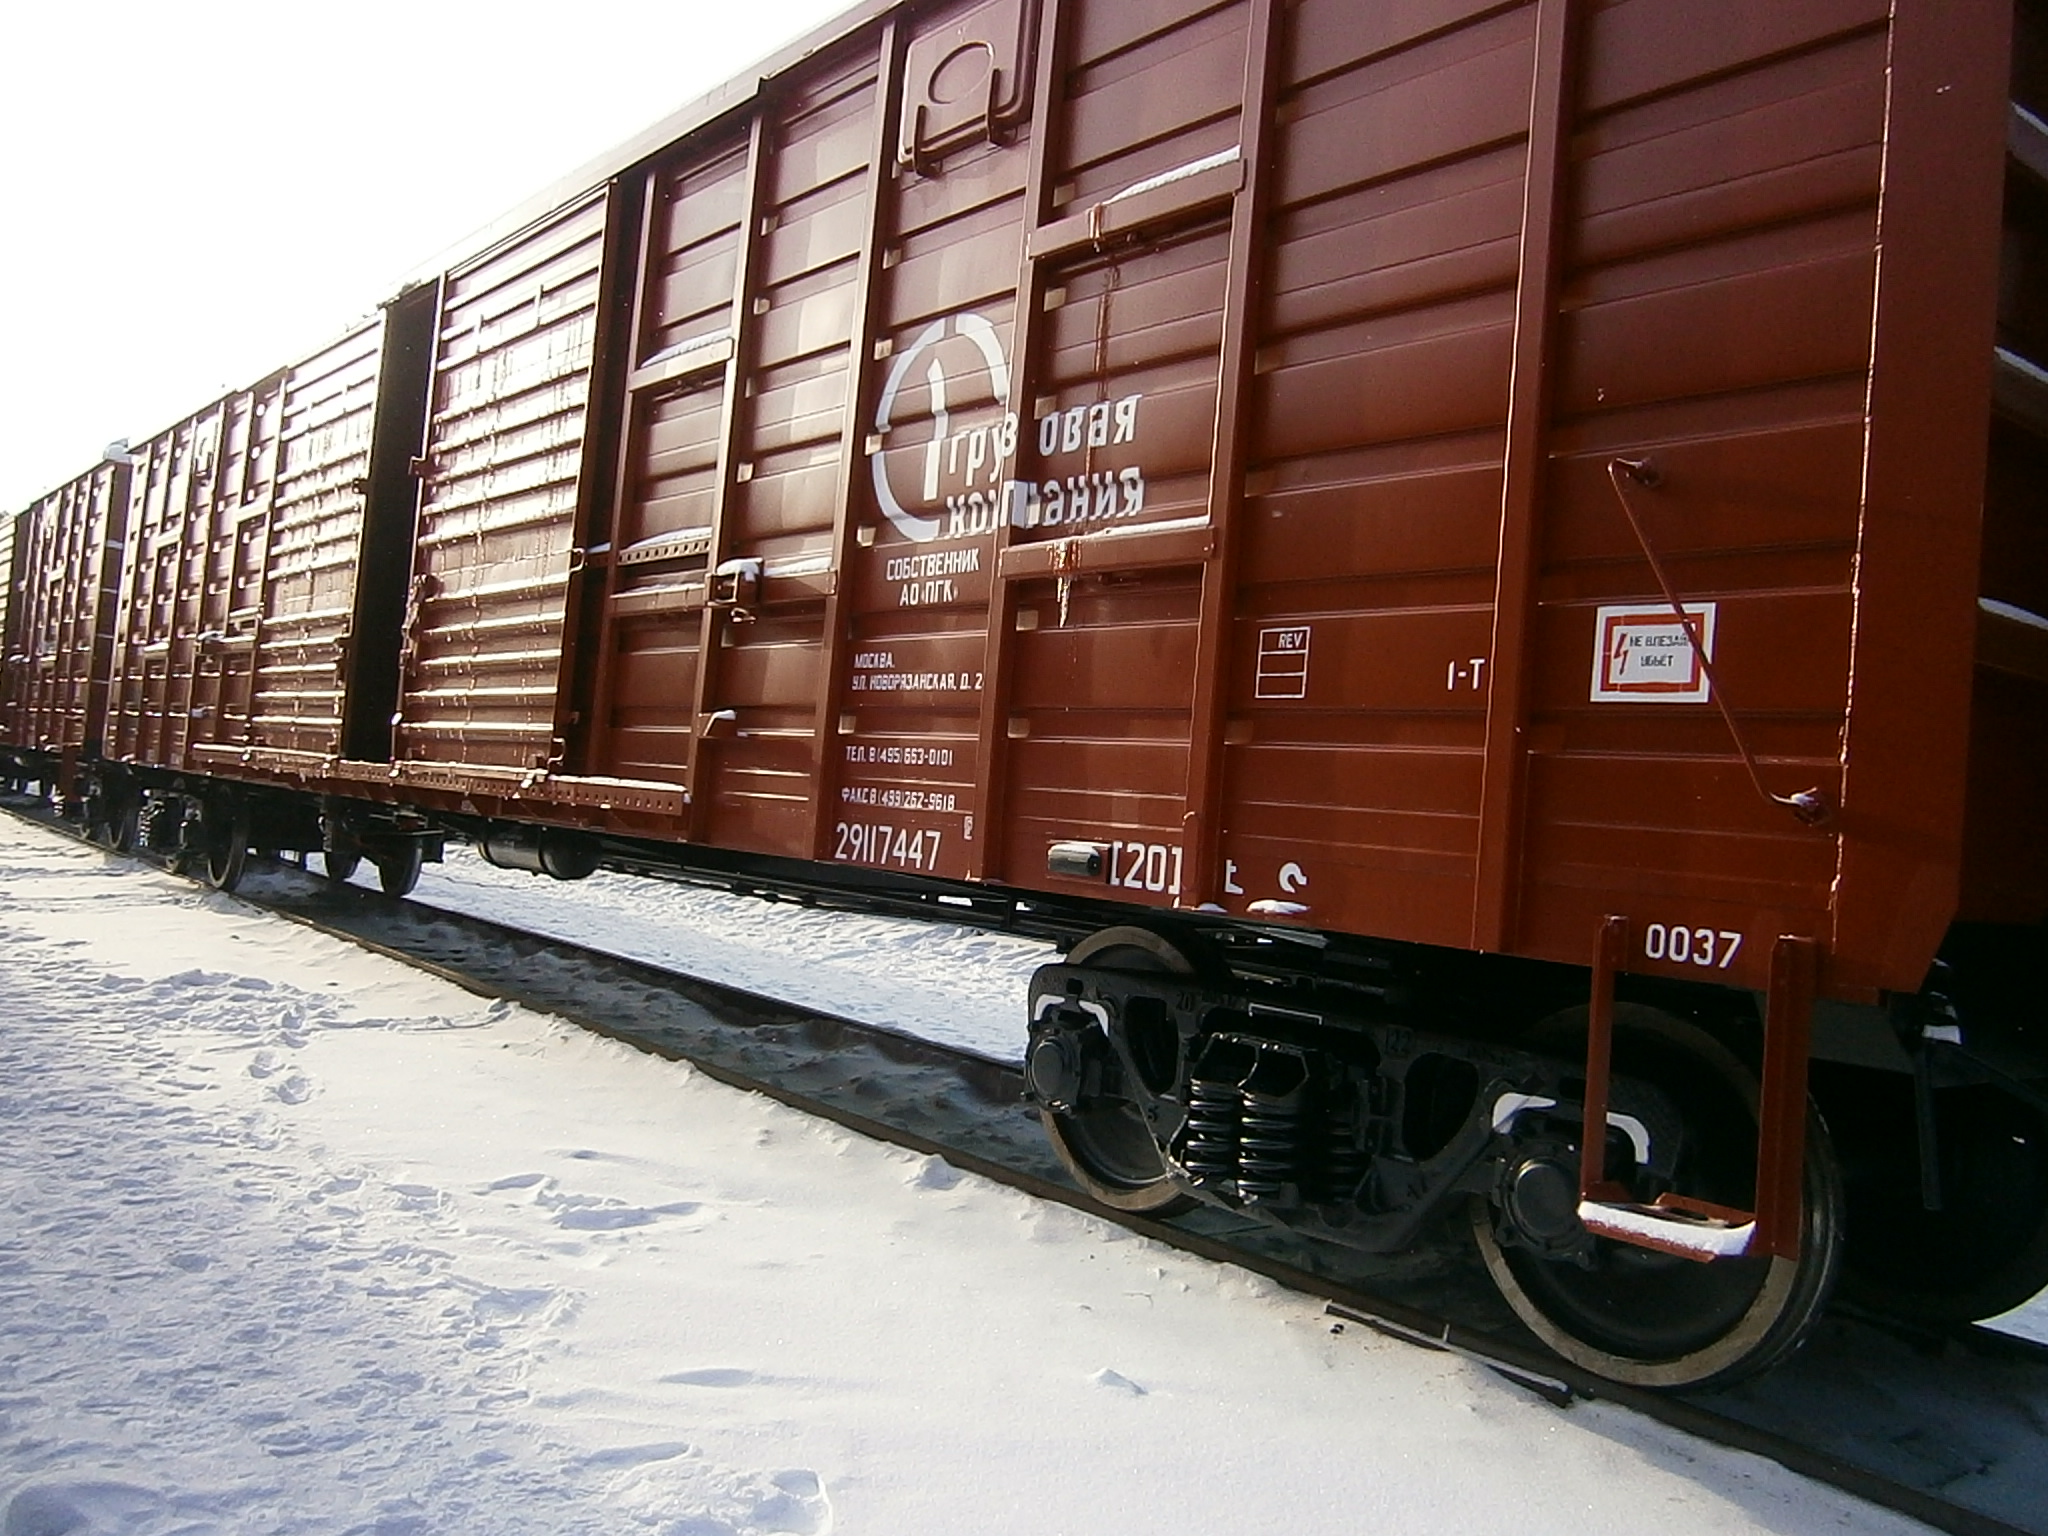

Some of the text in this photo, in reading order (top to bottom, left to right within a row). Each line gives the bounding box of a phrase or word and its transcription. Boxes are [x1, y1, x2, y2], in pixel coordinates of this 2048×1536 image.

[886, 547, 979, 581] СОБСТВЕННИК
[899, 583, 920, 606] АО
[1278, 632, 1303, 649] REV
[845, 745, 867, 762] ТЕЛ.
[841, 787, 868, 803] ФАКС
[834, 821, 942, 871] 29117447
[1645, 923, 1742, 969] 0037
